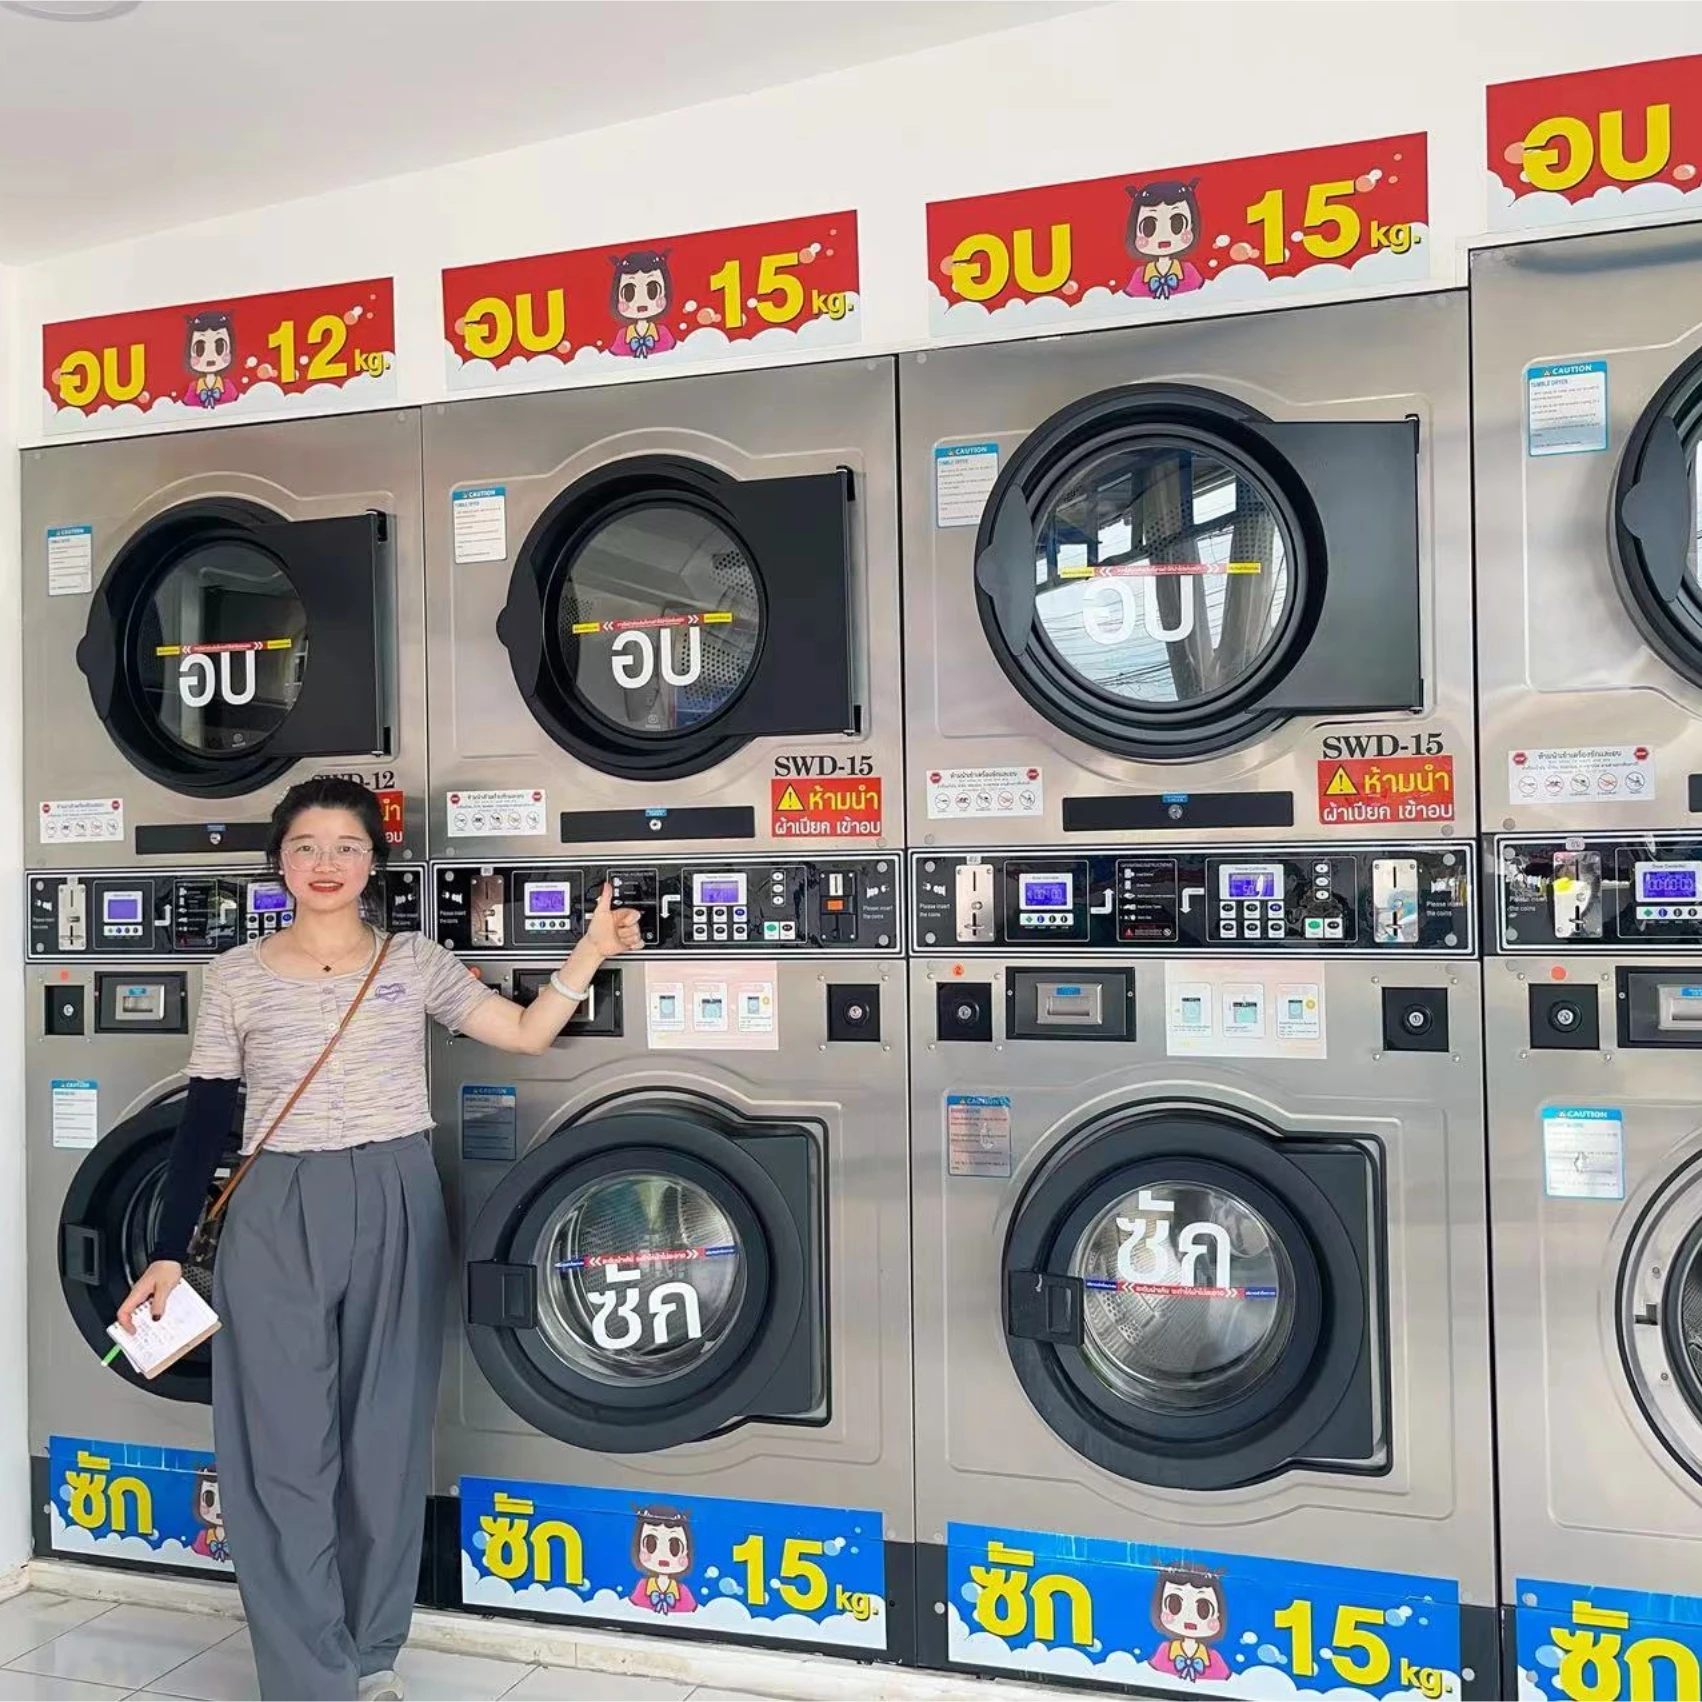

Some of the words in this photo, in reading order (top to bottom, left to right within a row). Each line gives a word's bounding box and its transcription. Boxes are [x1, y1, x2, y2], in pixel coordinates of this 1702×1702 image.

[1523, 104, 1670, 191] อบ
[951, 224, 1073, 300] อบ
[1246, 180, 1362, 266] 15
[1370, 221, 1421, 253] kg.
[463, 288, 566, 359] อบ
[710, 252, 805, 329] 15
[811, 290, 854, 320] kg.
[60, 344, 146, 407] อบ
[268, 315, 348, 383] 12
[354, 349, 391, 377] kg.
[1552, 364, 1592, 376] CAUTION
[955, 446, 988, 455] CAUTION
[468, 490, 496, 499] CAUTION
[1083, 575, 1195, 645] อบ
[179, 650, 256, 708] อบ
[612, 626, 700, 689] อบ
[774, 755, 873, 777] SWD-15
[1322, 732, 1444, 760] SWD-15
[809, 783, 879, 811] ห้ามนำ
[1364, 764, 1450, 795] ห้ามนำ
[775, 817, 830, 835] ผ้าเปียก
[836, 816, 881, 835] เข้าอบ
[1323, 802, 1391, 823] ผ้าเปียก
[1399, 800, 1453, 820] เข้าอบ
[1567, 1111, 1608, 1119] CAUTION
[1116, 1190, 1231, 1287] ซัก
[587, 1263, 703, 1350] ซัก
[65, 1451, 153, 1535] ซัก
[479, 1493, 584, 1586] ซัก
[733, 1534, 829, 1612] 15
[836, 1584, 879, 1621] kg.
[969, 1541, 1094, 1646] ซัก
[1274, 1599, 1391, 1686] 15
[1400, 1658, 1453, 1700] kg.
[1550, 1600, 1701, 1702] ซัก
